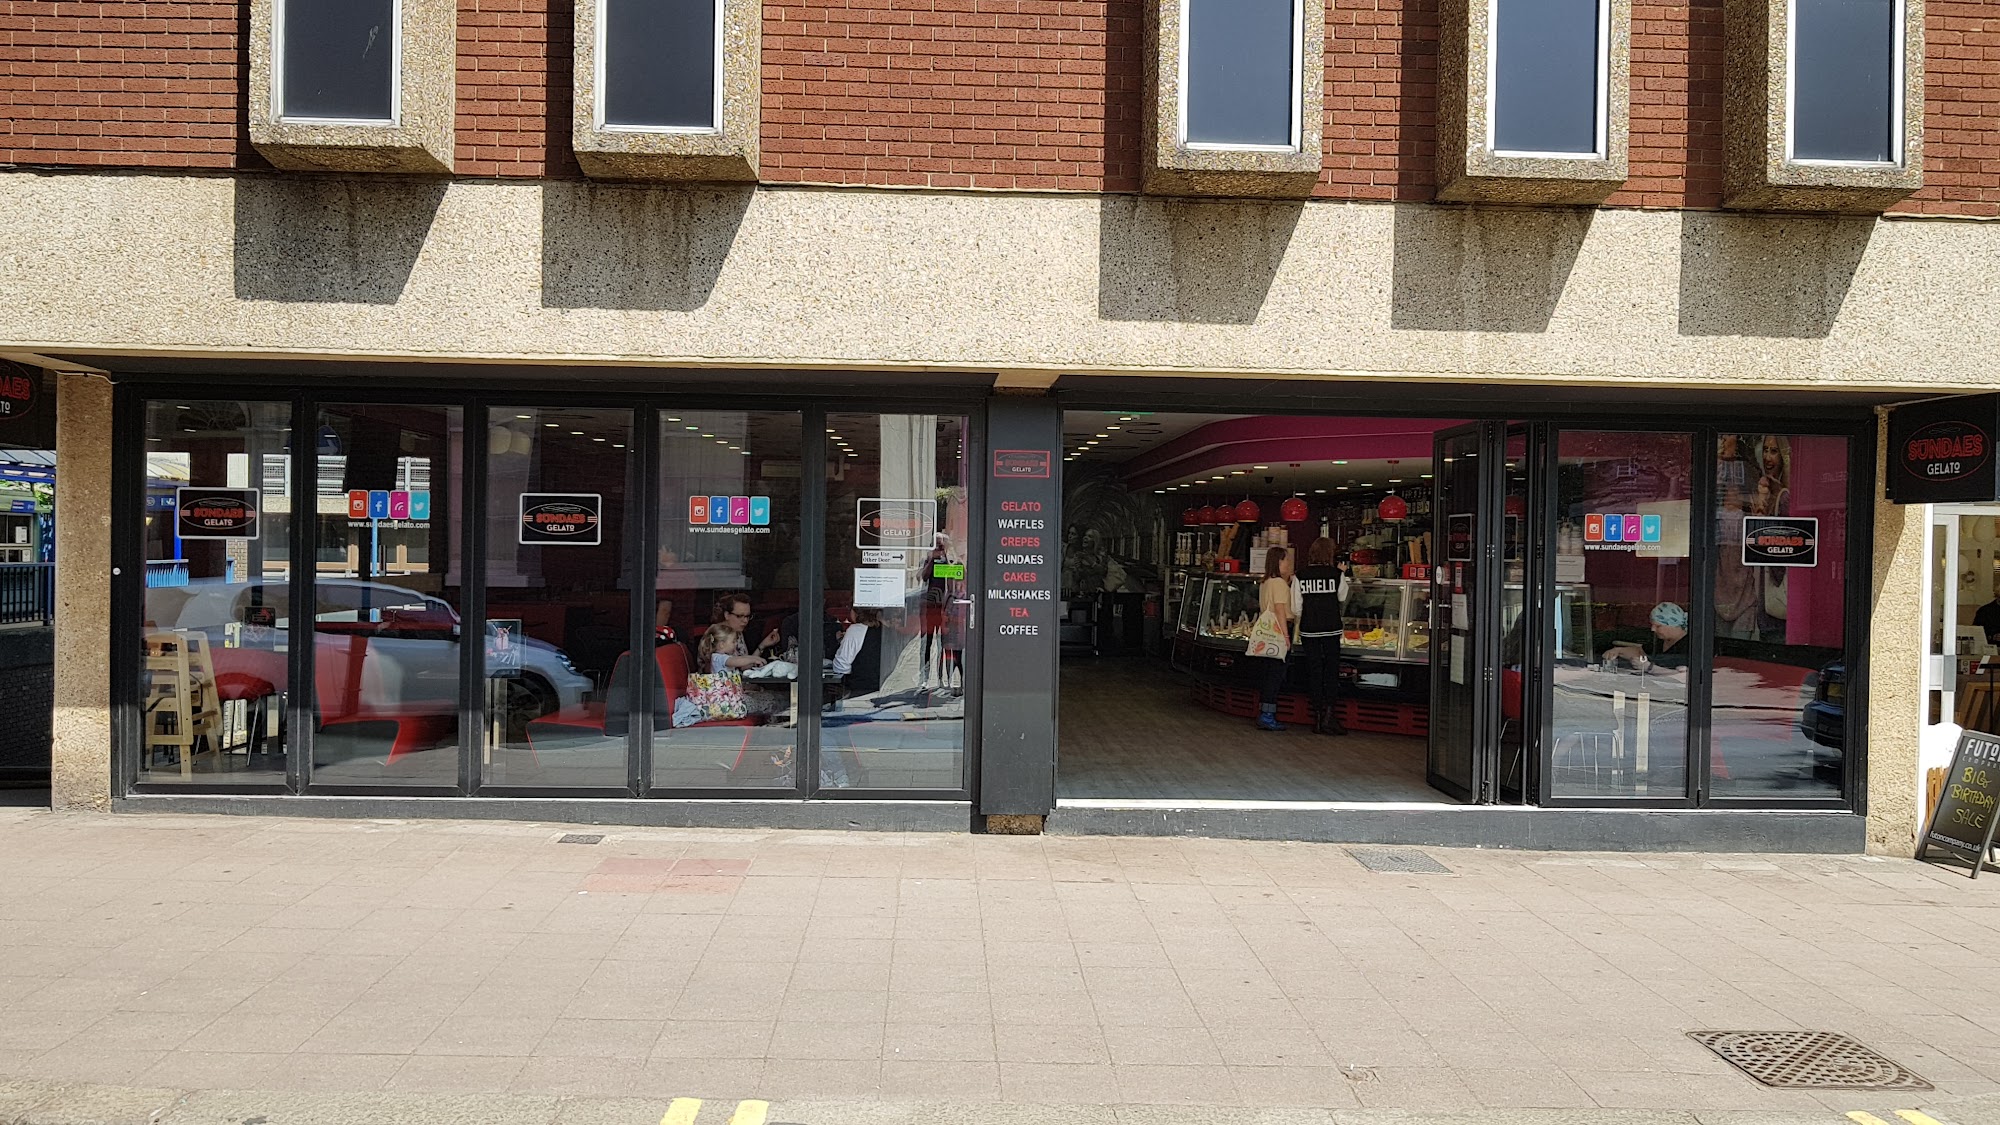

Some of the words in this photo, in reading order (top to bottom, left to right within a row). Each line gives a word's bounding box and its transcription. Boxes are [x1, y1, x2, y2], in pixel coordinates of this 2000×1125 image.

[1908, 434, 1983, 461] SUNDAES
[1927, 462, 1961, 475] GELATO
[1001, 501, 1042, 512] GELATO
[536, 513, 586, 524] SUNDAES
[998, 519, 1044, 529] WAFFLES
[546, 524, 575, 532] GELATO
[689, 526, 770, 534] www.sundaesgelato.com
[883, 529, 911, 537] GELATO
[1001, 537, 1040, 547] CREPES
[1585, 544, 1661, 552] www.sundaesgelato.com
[997, 554, 1044, 565] SUNDAES
[1003, 572, 1037, 582] CAKES
[1300, 579, 1336, 593] SHIELD
[988, 589, 1051, 600] MILKSHAKES
[1009, 607, 1029, 618] TEA
[1000, 625, 1038, 635] COFFEE
[1964, 739, 2000, 763] FUTO
[1961, 766, 1992, 789] BIG
[1950, 783, 1996, 814] BIRTHDAY
[1952, 808, 1986, 829] SALE
[1929, 830, 1981, 853] futoncompany.co.uk
